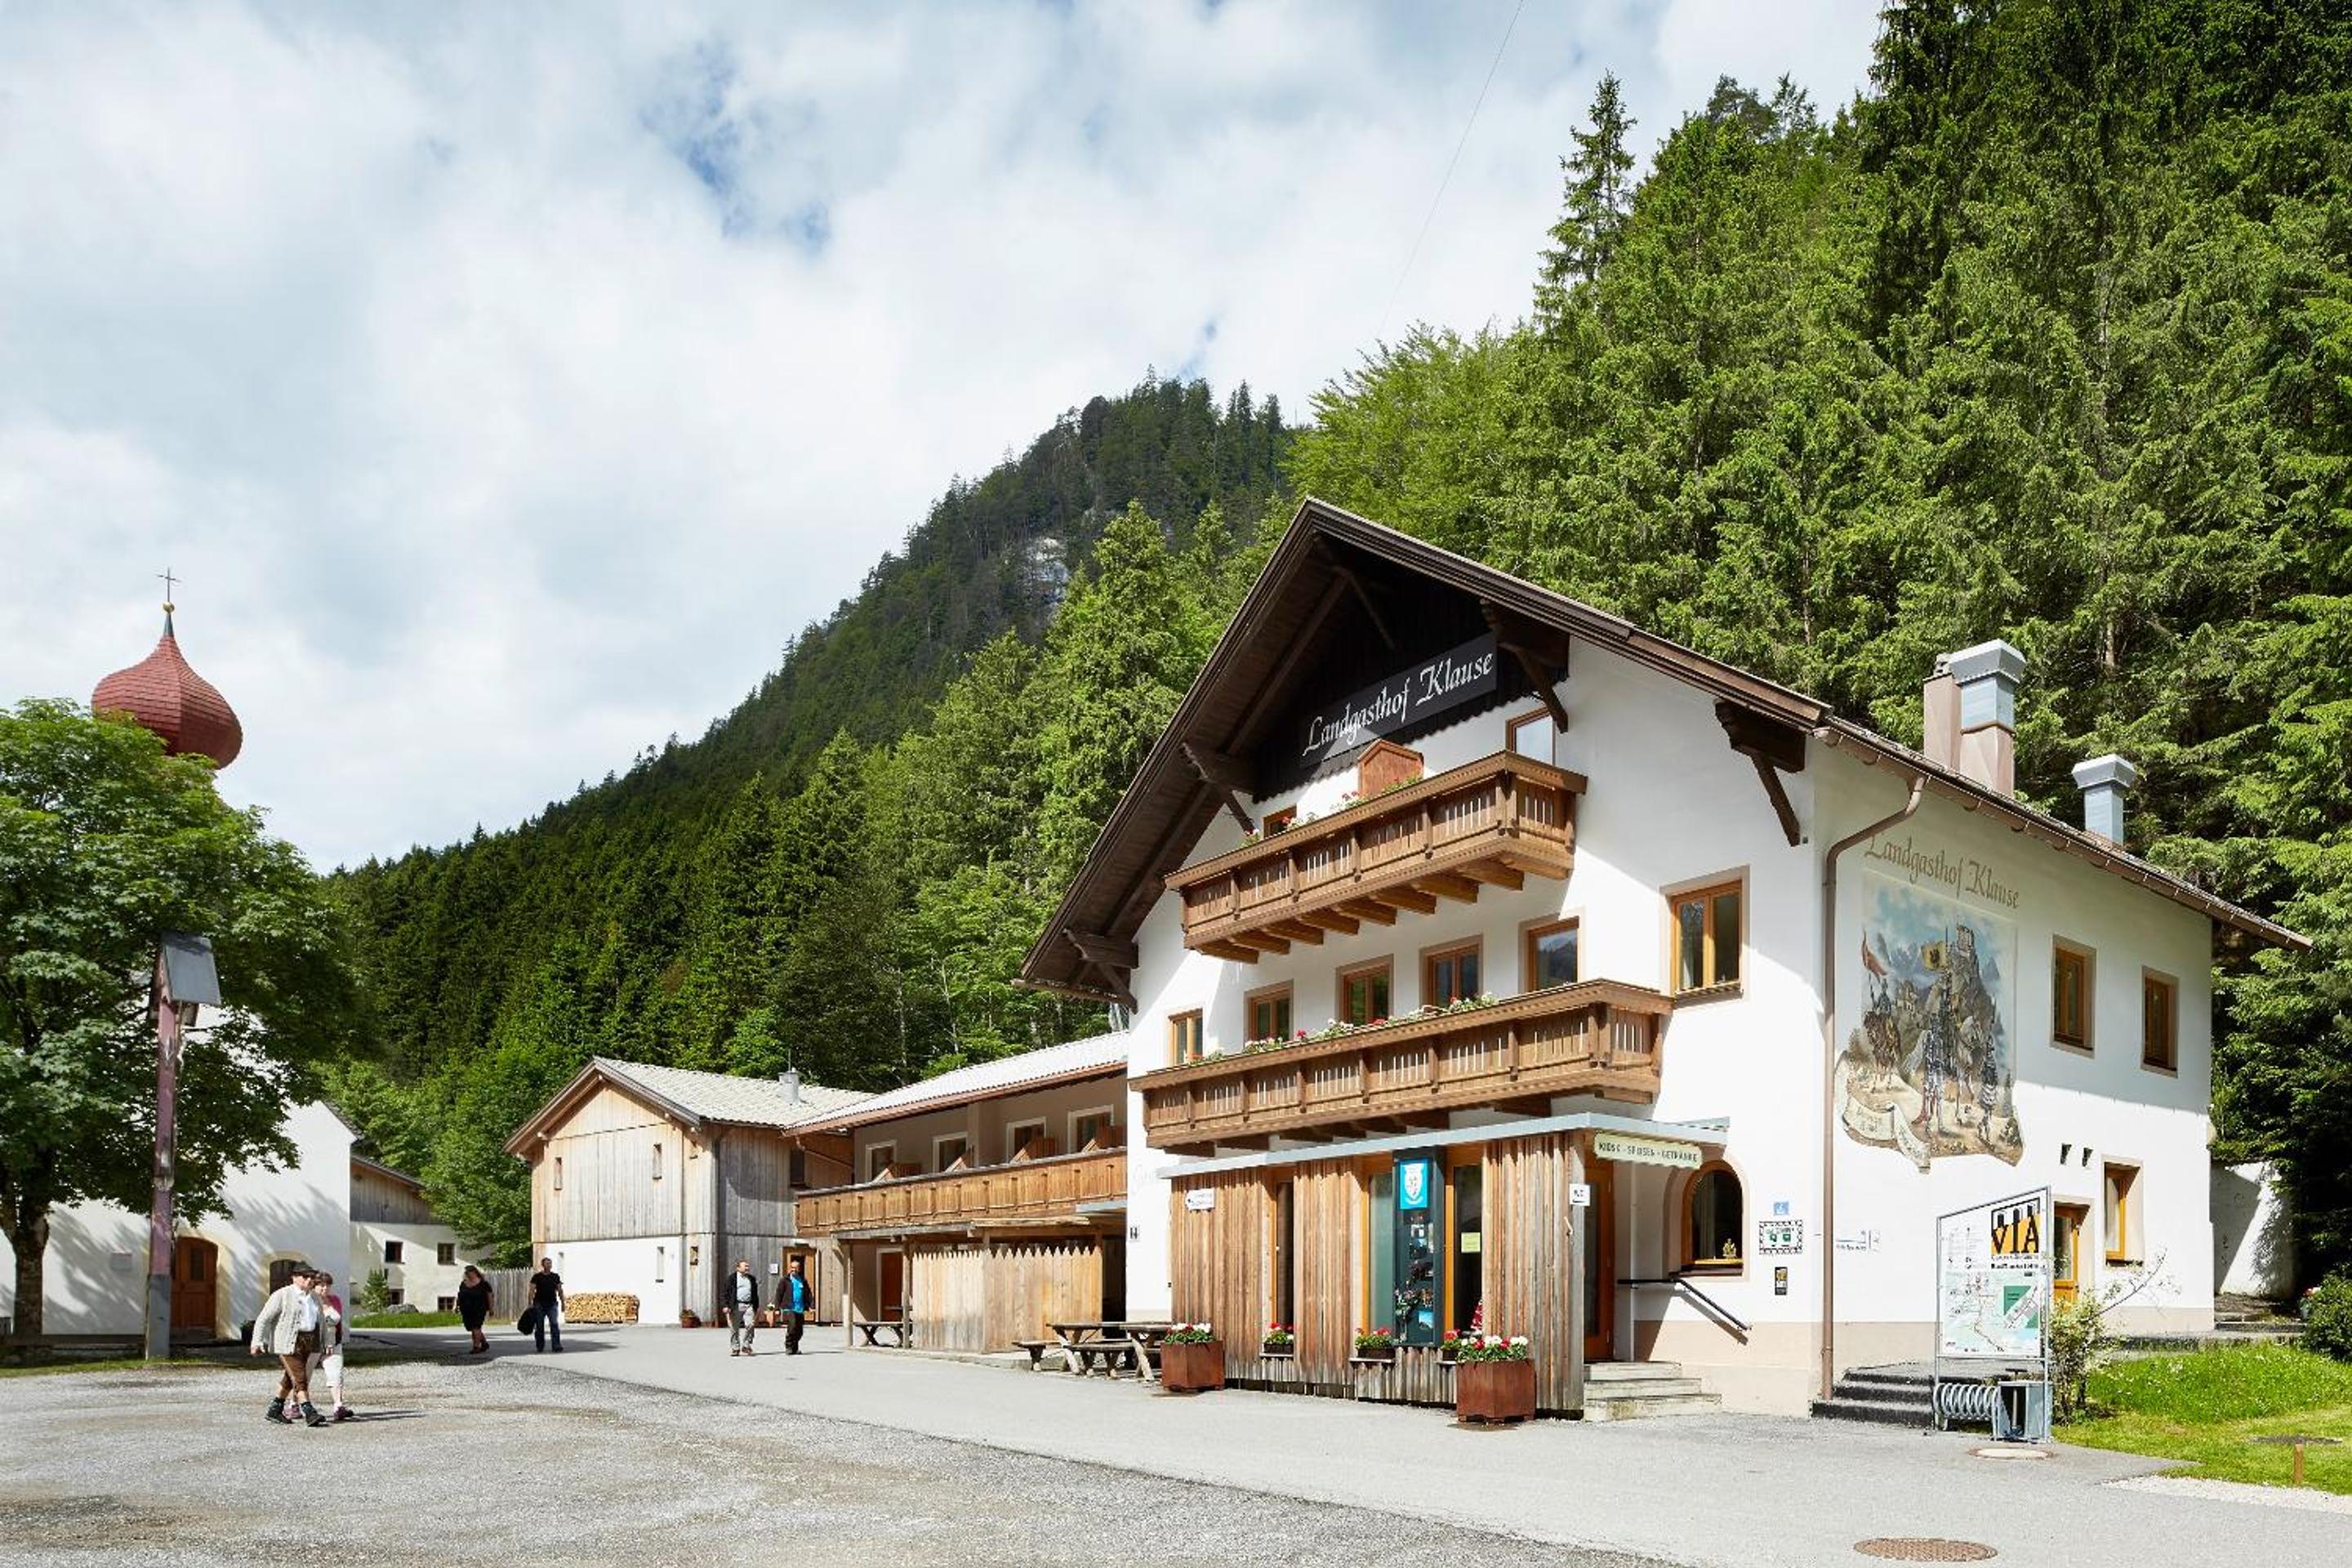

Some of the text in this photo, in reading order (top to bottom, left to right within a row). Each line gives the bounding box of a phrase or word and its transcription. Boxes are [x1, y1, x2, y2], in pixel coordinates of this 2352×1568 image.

[1302, 653, 1494, 756] Landgasthof Klause
[1864, 833, 2019, 908] Landgasthof Klause
[1991, 1214, 2039, 1254] VIA
